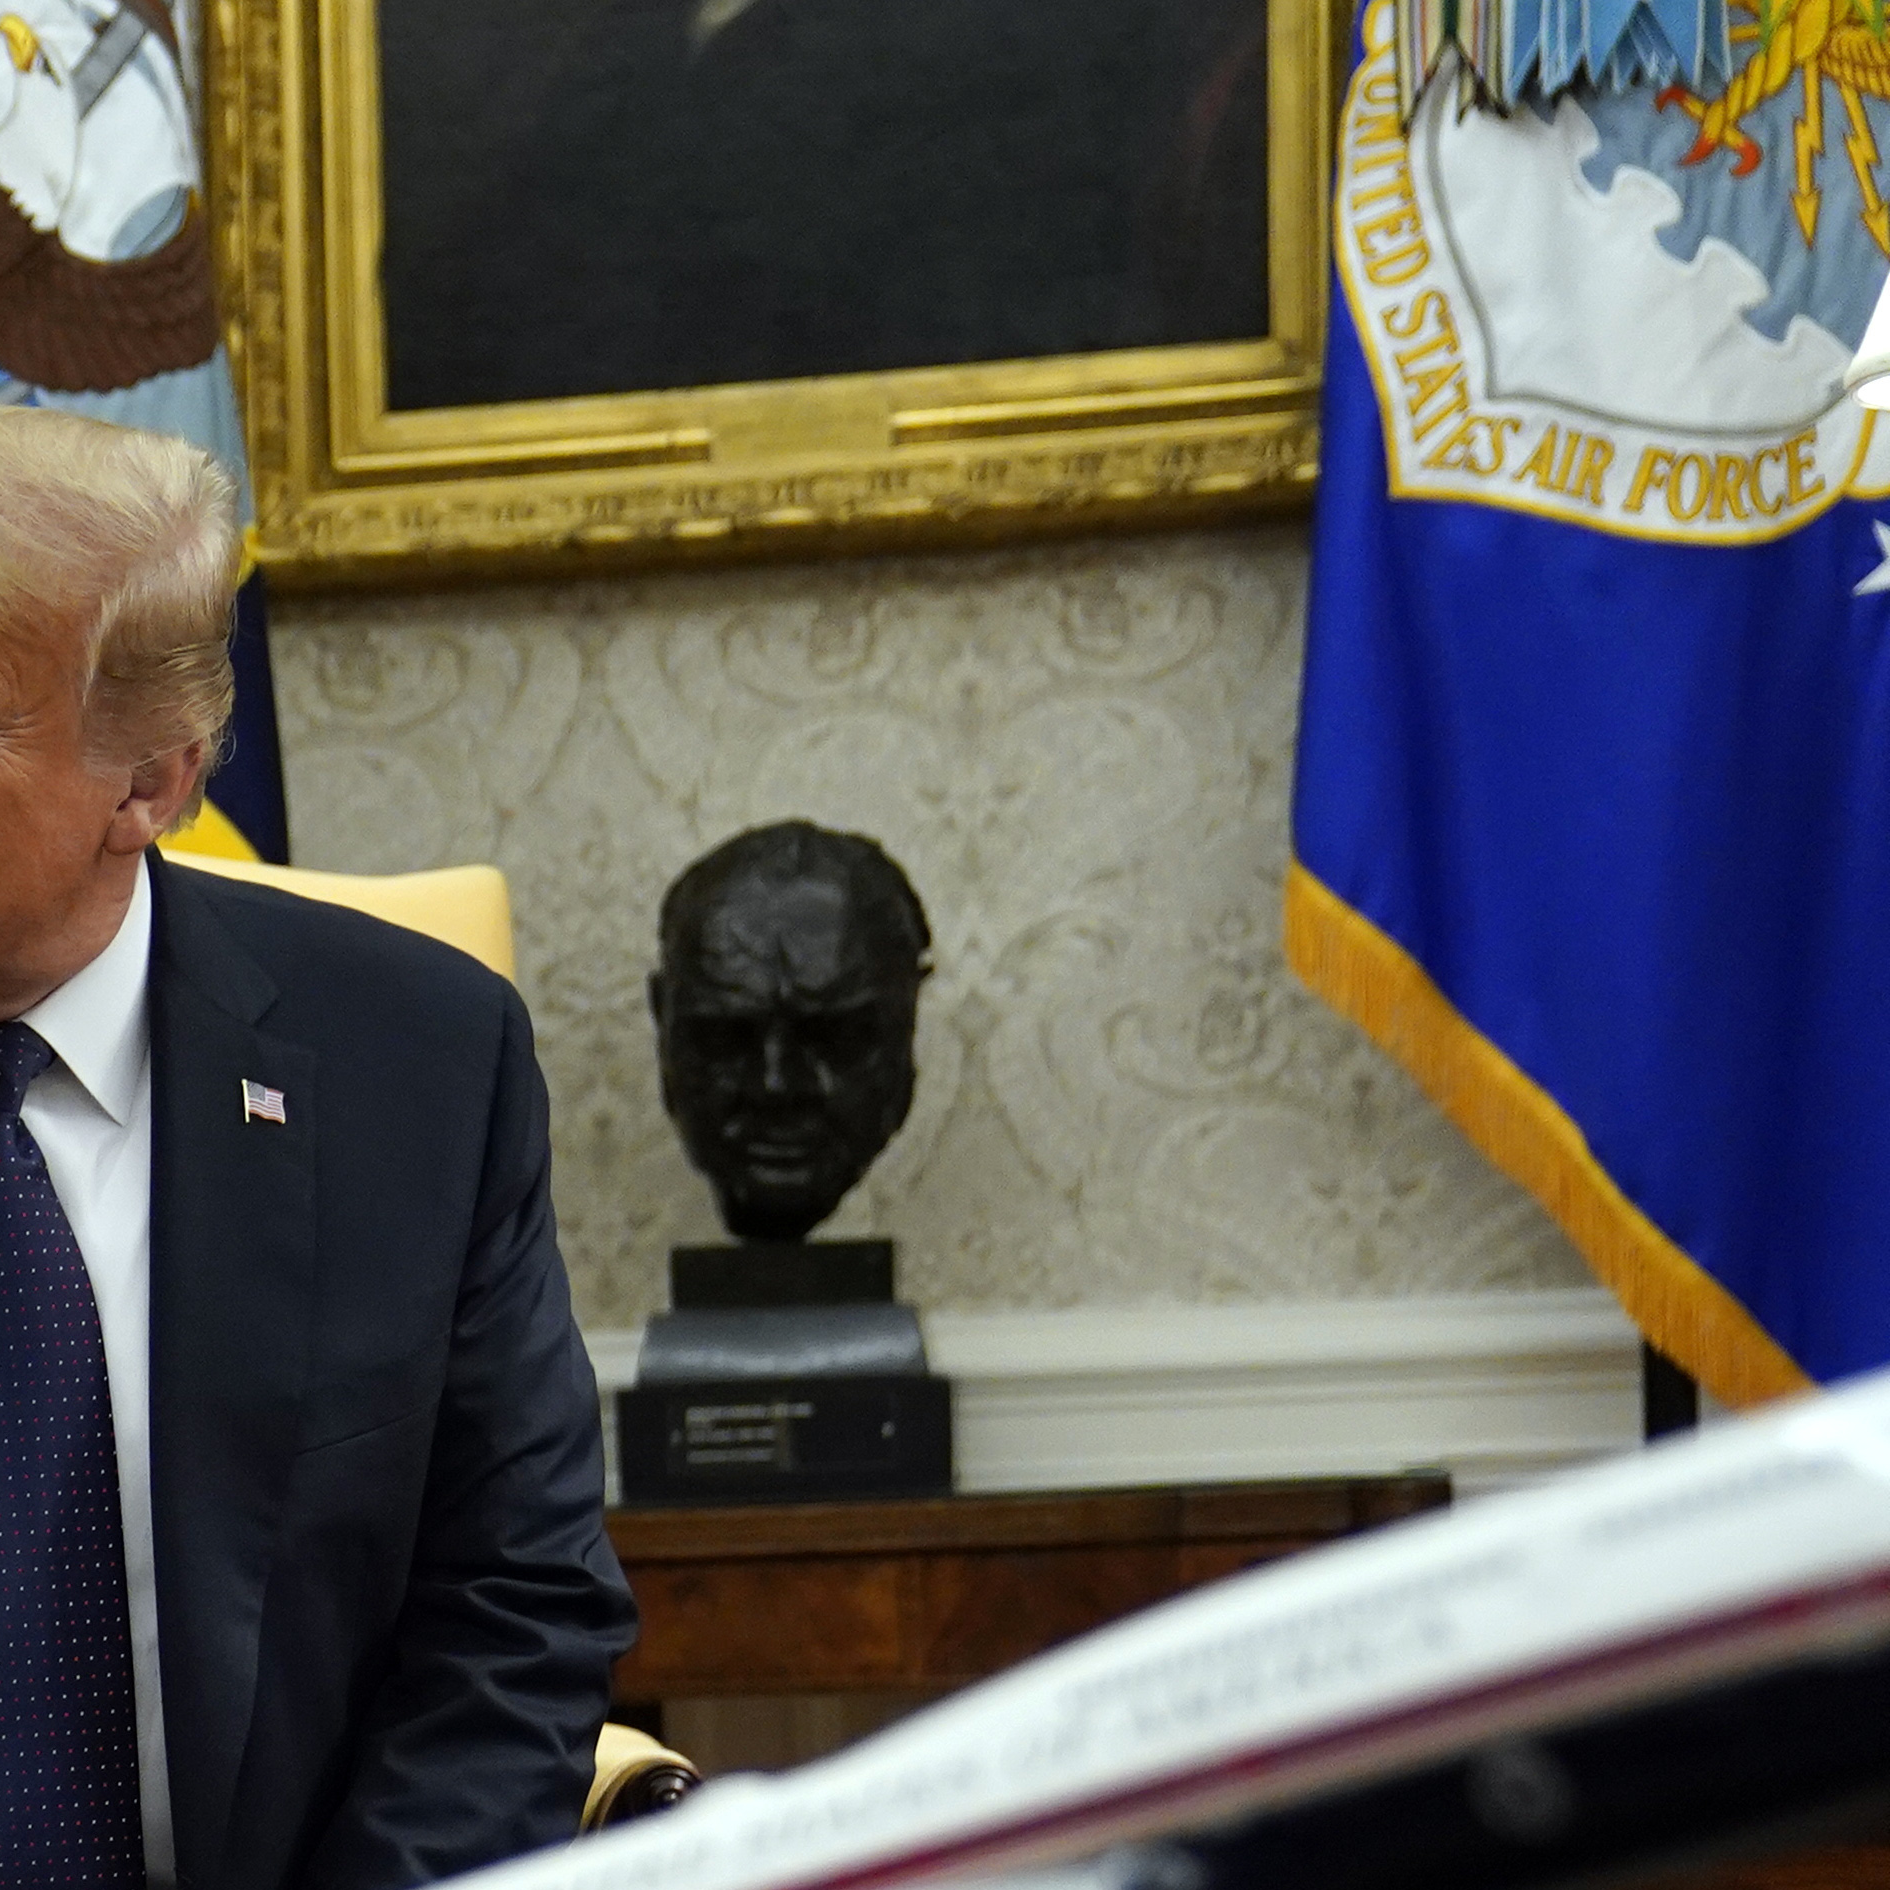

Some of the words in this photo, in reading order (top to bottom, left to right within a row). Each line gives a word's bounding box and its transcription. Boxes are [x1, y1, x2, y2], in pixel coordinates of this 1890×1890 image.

[1351, 70, 1431, 287] UNITED
[1380, 289, 1522, 477] STATES
[1512, 421, 1615, 506] AIR
[1623, 427, 1826, 522] FORCE
